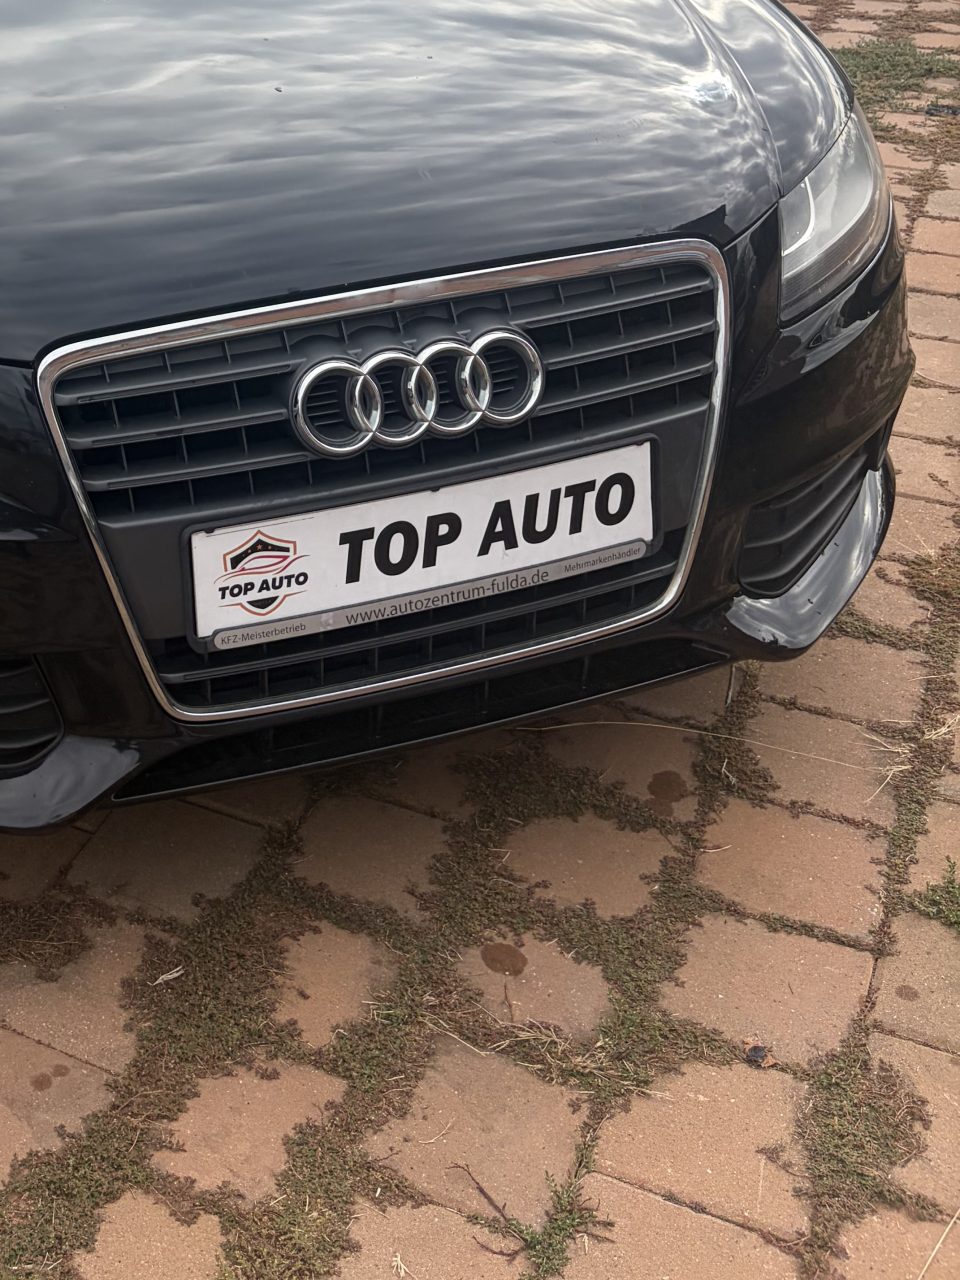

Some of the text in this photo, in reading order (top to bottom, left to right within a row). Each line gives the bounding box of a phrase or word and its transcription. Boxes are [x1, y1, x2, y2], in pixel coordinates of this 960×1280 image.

[339, 472, 636, 584] TOP AUTO
[218, 572, 309, 600] TOP AUTO
[221, 547, 641, 645] KFZ-Meisterbetrieb www.autozentrum-fulda.de Mehrmarkenhändler
